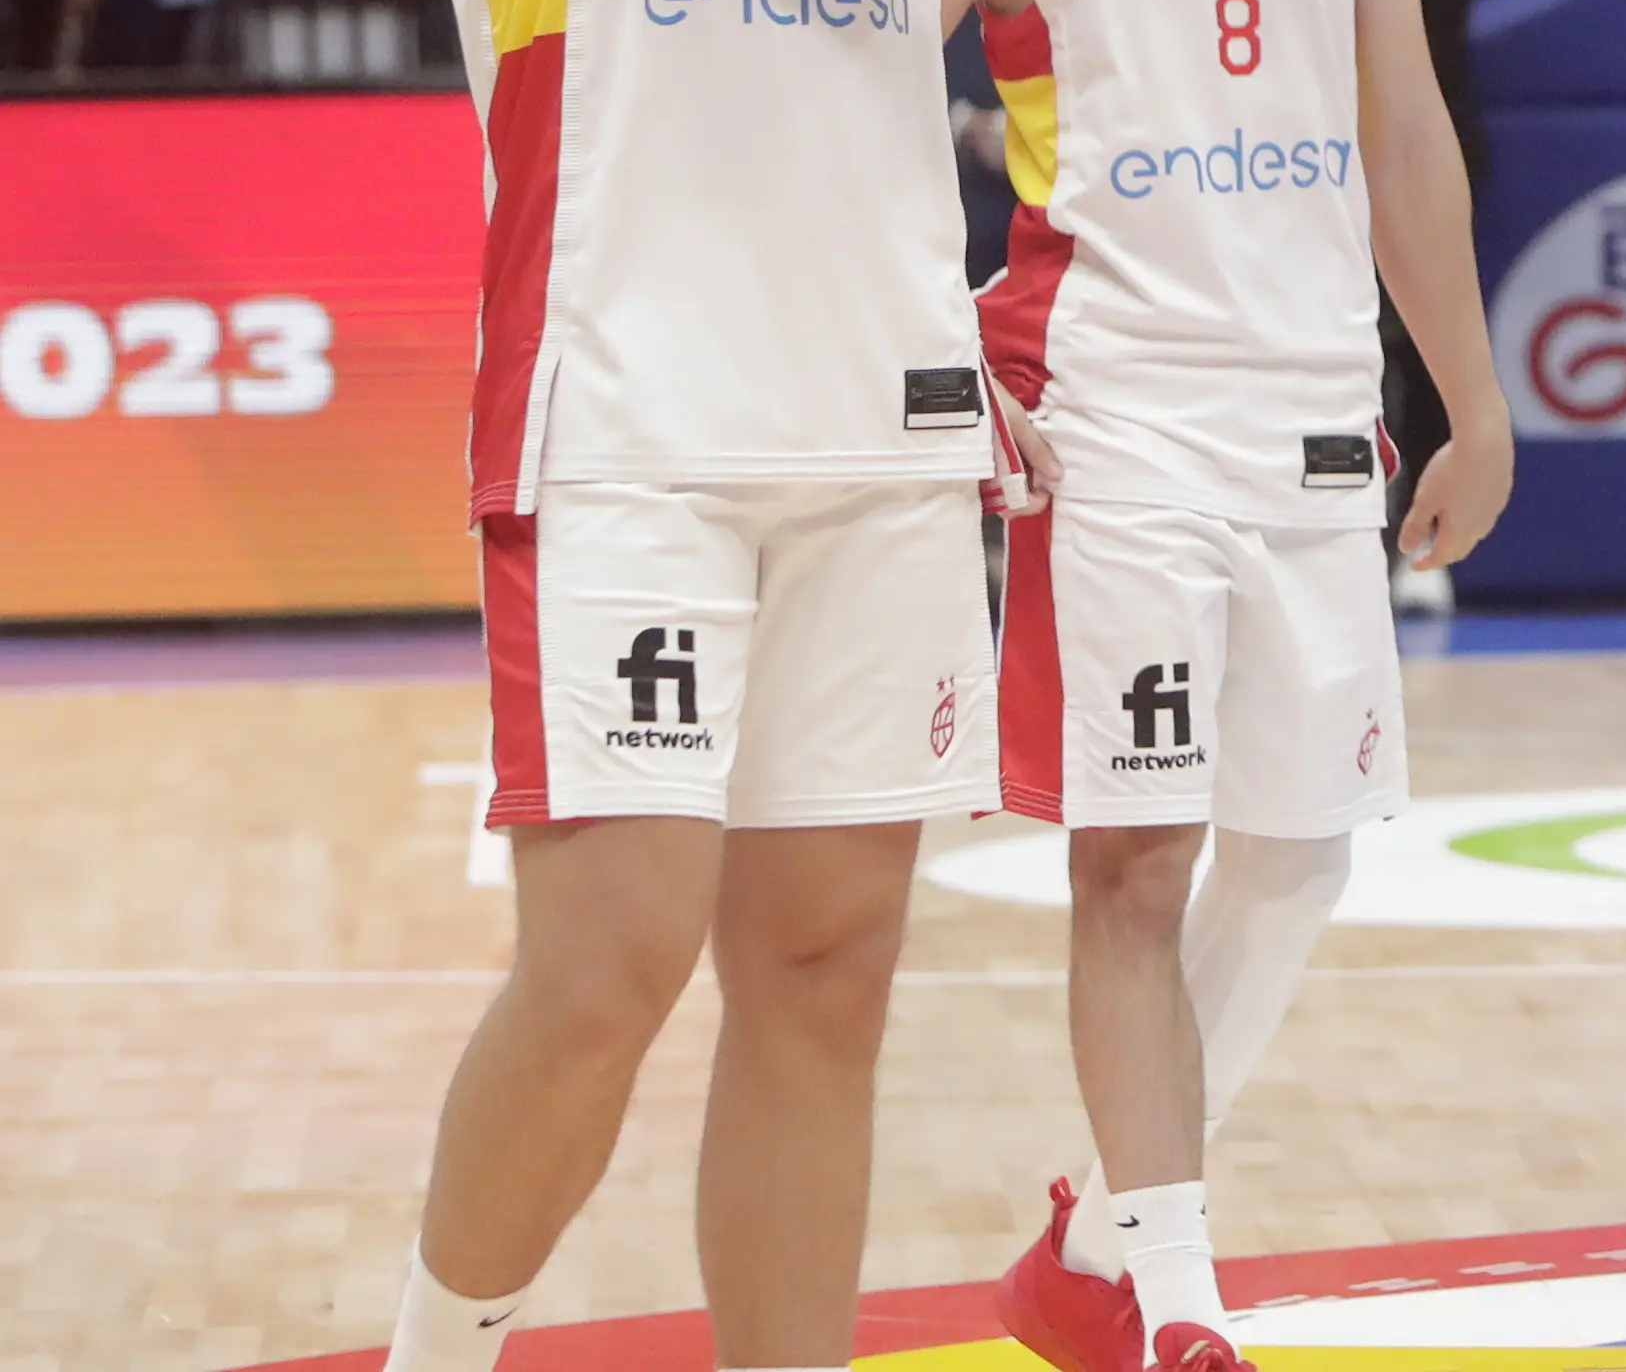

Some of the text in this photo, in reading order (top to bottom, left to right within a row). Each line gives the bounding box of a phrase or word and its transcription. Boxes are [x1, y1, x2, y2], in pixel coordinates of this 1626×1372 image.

[1109, 127, 1352, 199] endesa
[616, 626, 699, 725] fi
[1121, 661, 1192, 749] fi
[605, 727, 715, 752] network
[1110, 744, 1207, 772] network
